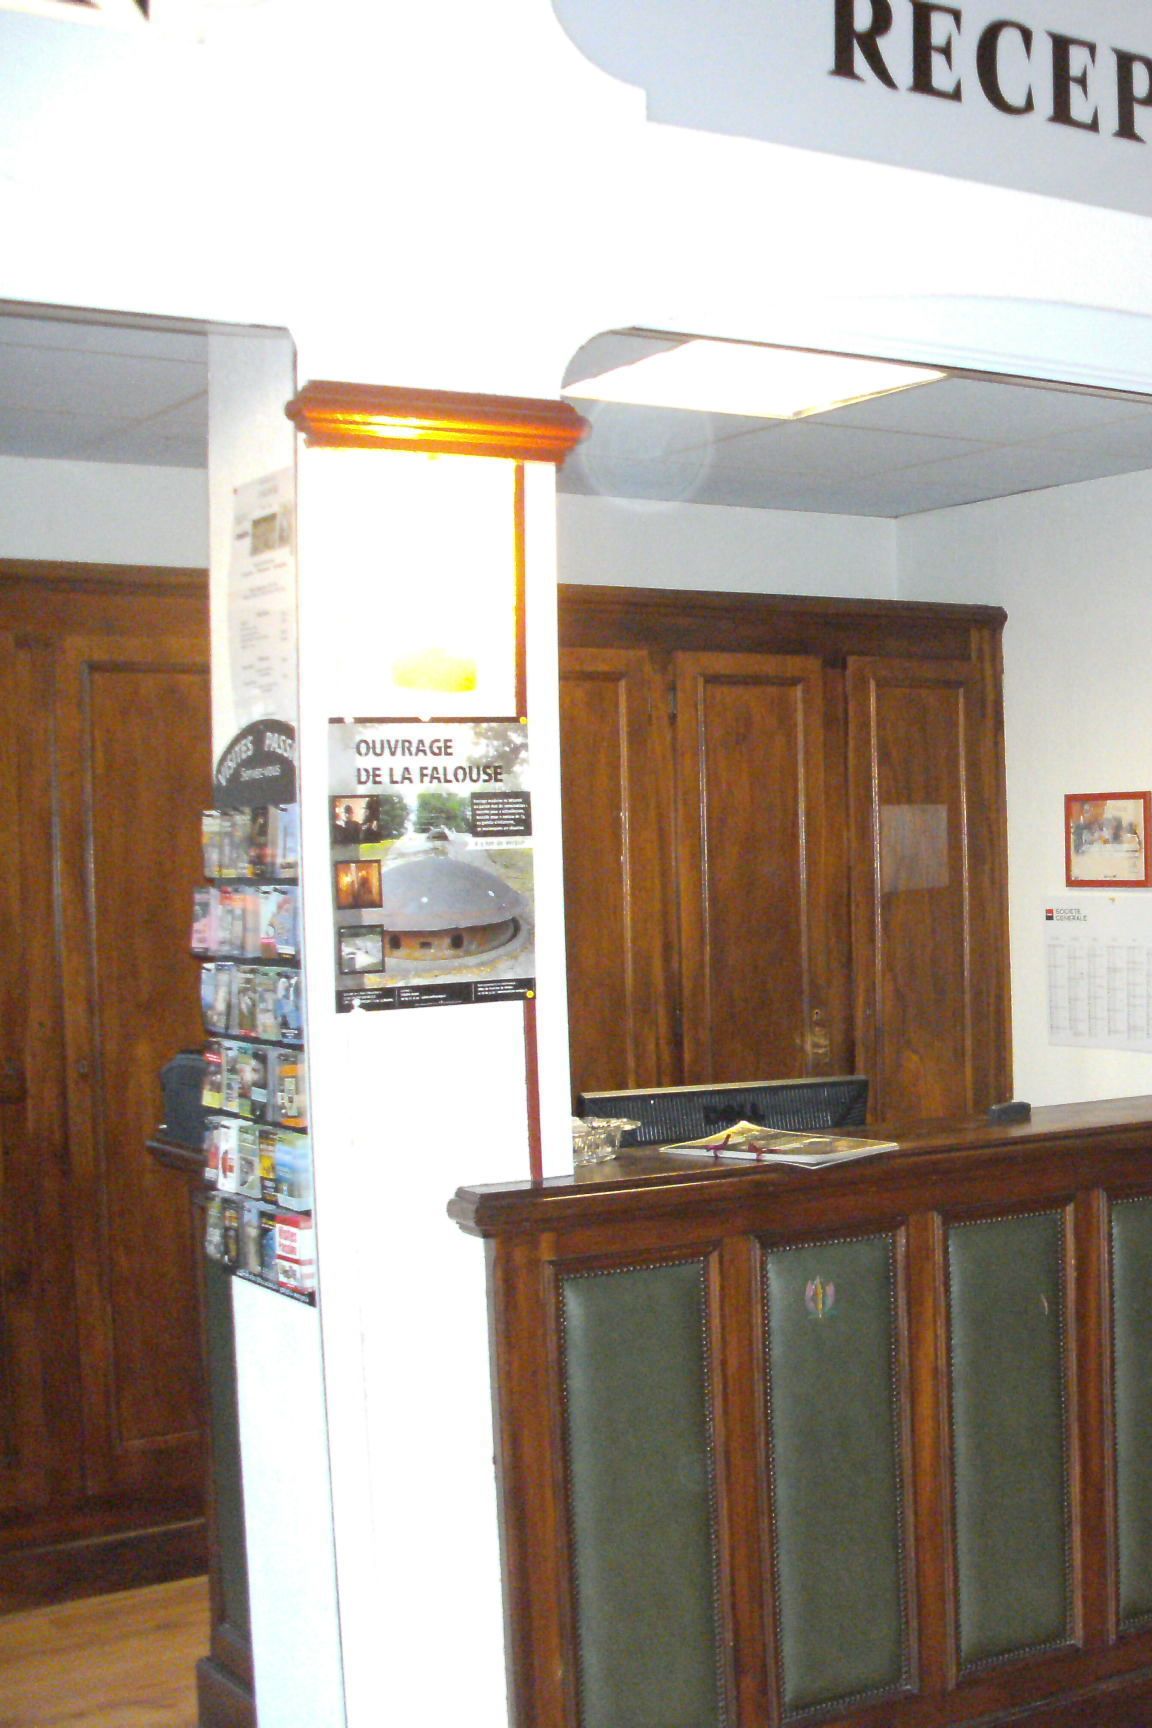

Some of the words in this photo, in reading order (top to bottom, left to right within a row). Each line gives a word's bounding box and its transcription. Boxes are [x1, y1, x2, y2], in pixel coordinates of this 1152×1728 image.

[356, 738, 453, 757] OUVRAGE
[356, 767, 383, 785] DE
[389, 767, 413, 785] LA
[419, 765, 503, 784] FALOUSE
